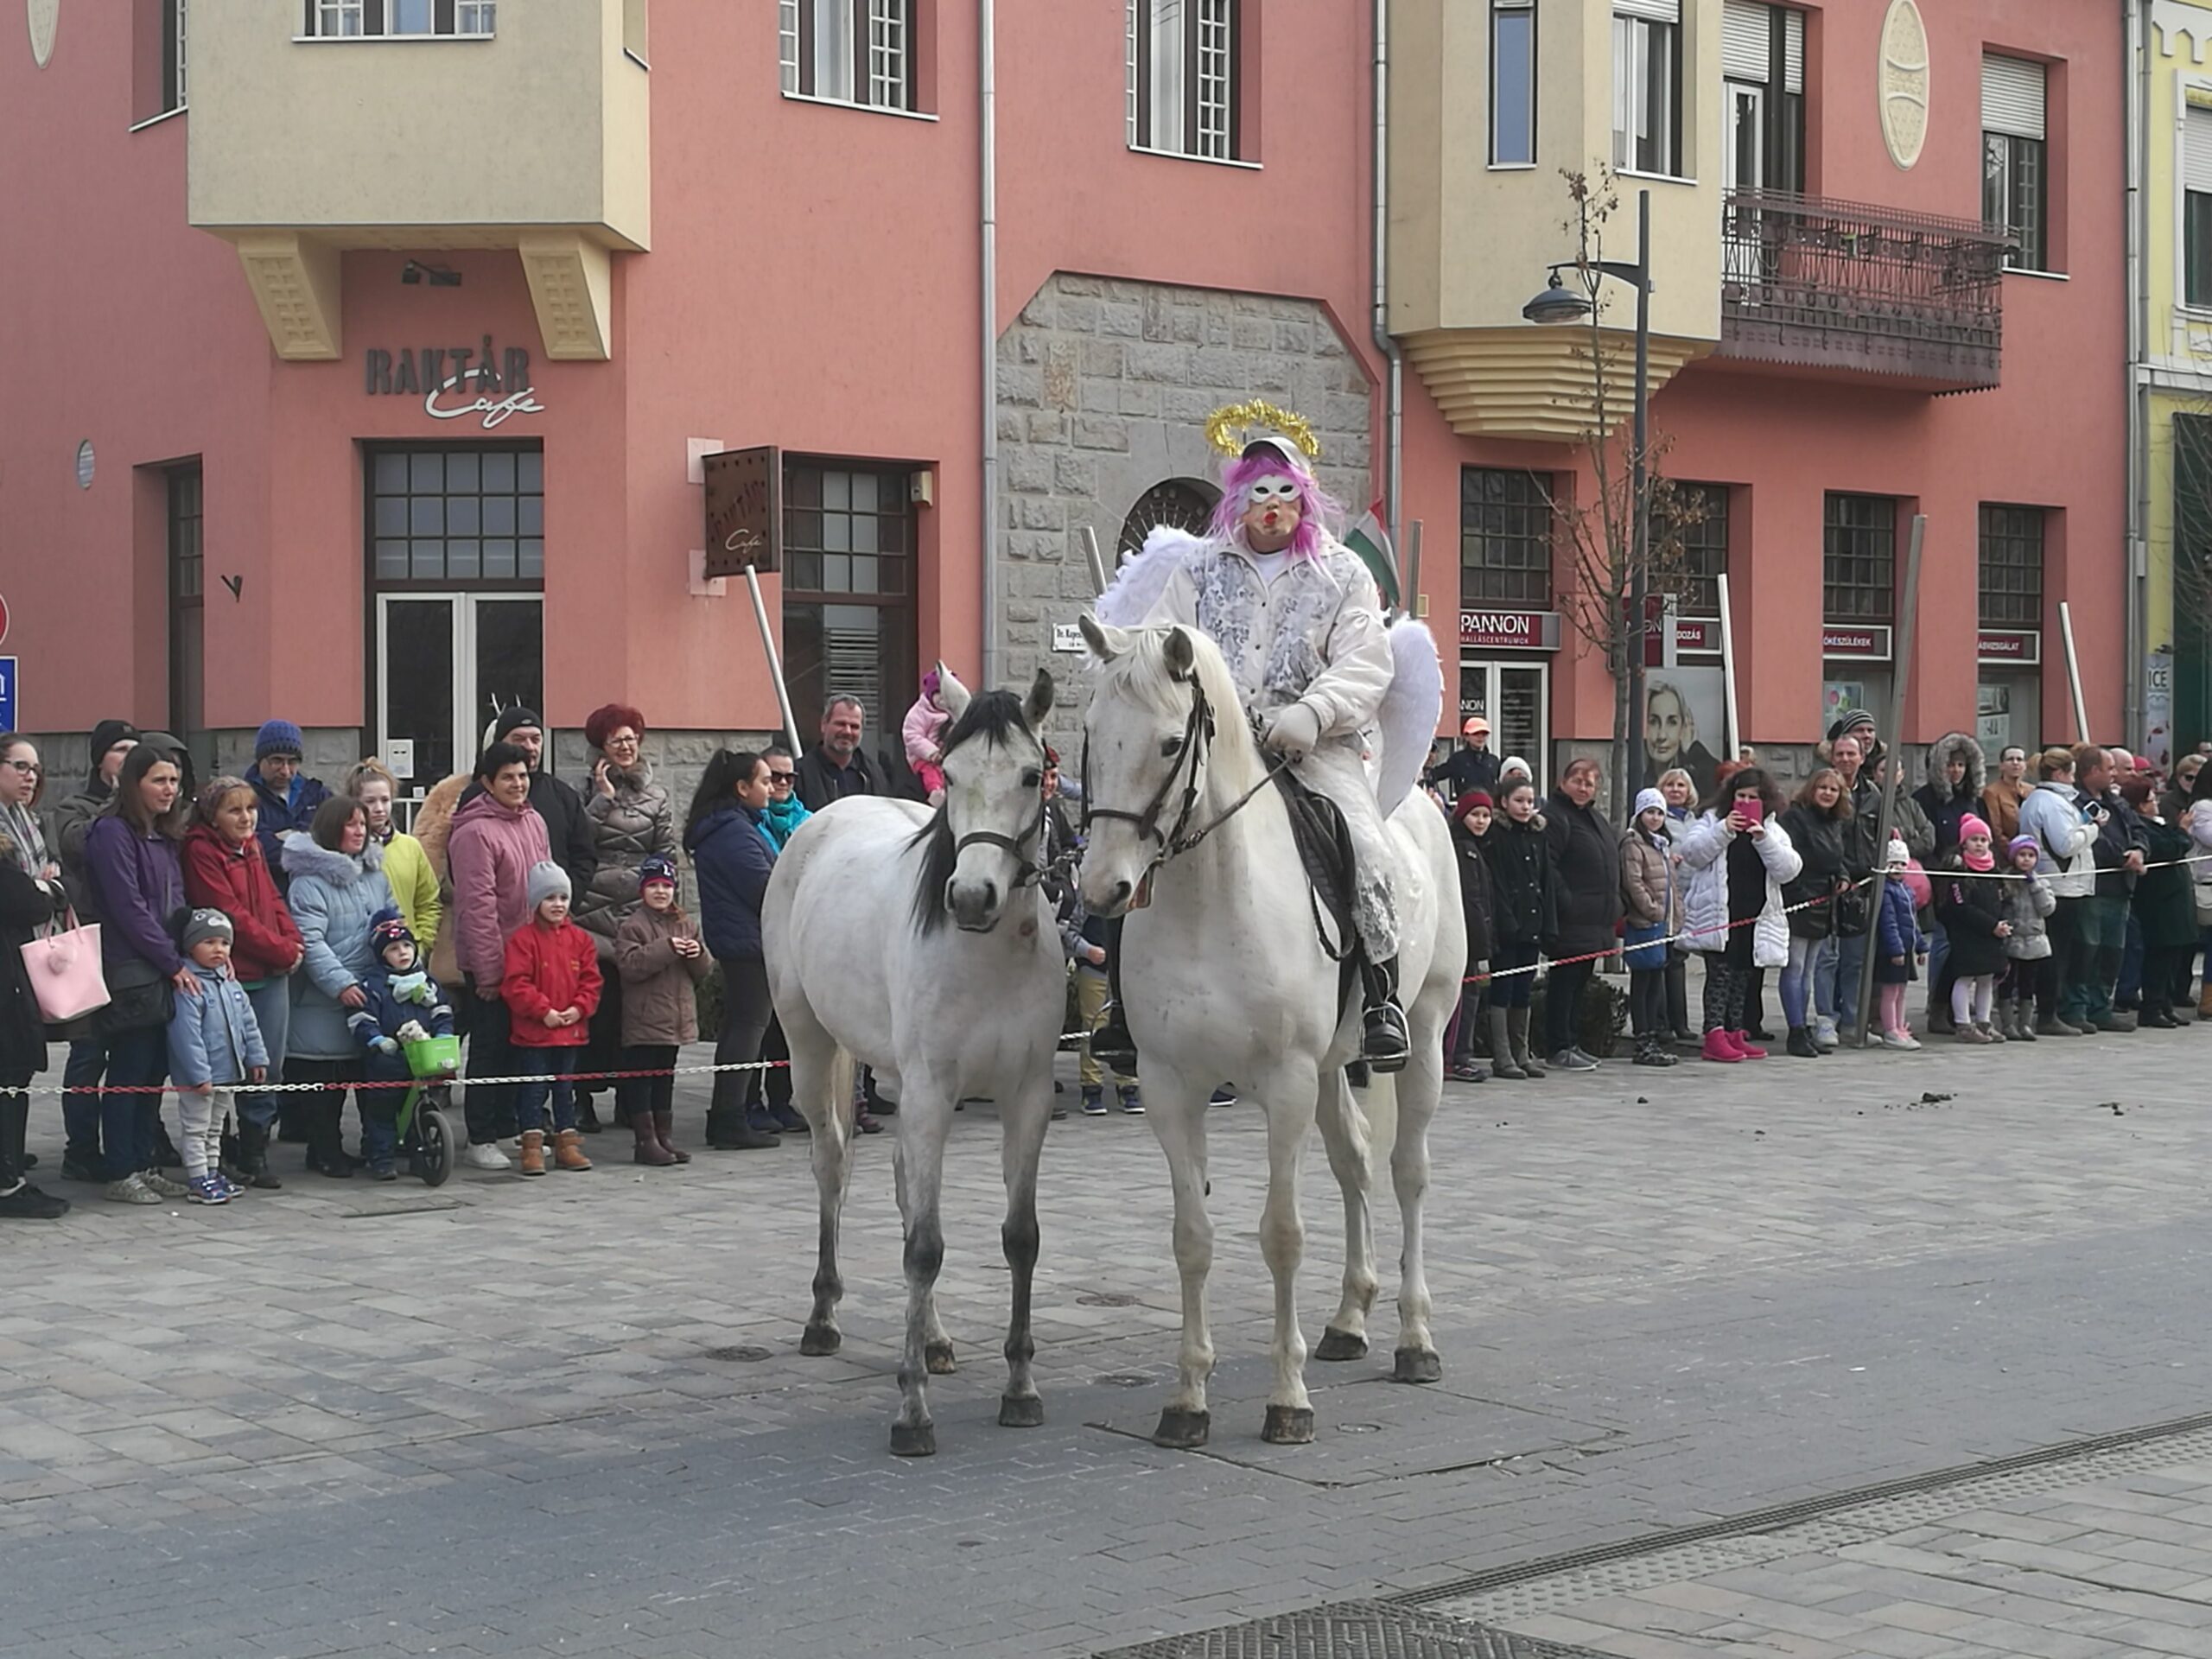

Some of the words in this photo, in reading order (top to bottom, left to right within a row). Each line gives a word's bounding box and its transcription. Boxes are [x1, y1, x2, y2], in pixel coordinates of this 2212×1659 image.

[366, 334, 529, 395] RAKTÁR
[1460, 614, 1529, 634] PANNON
[2148, 670, 2168, 688] ICE
